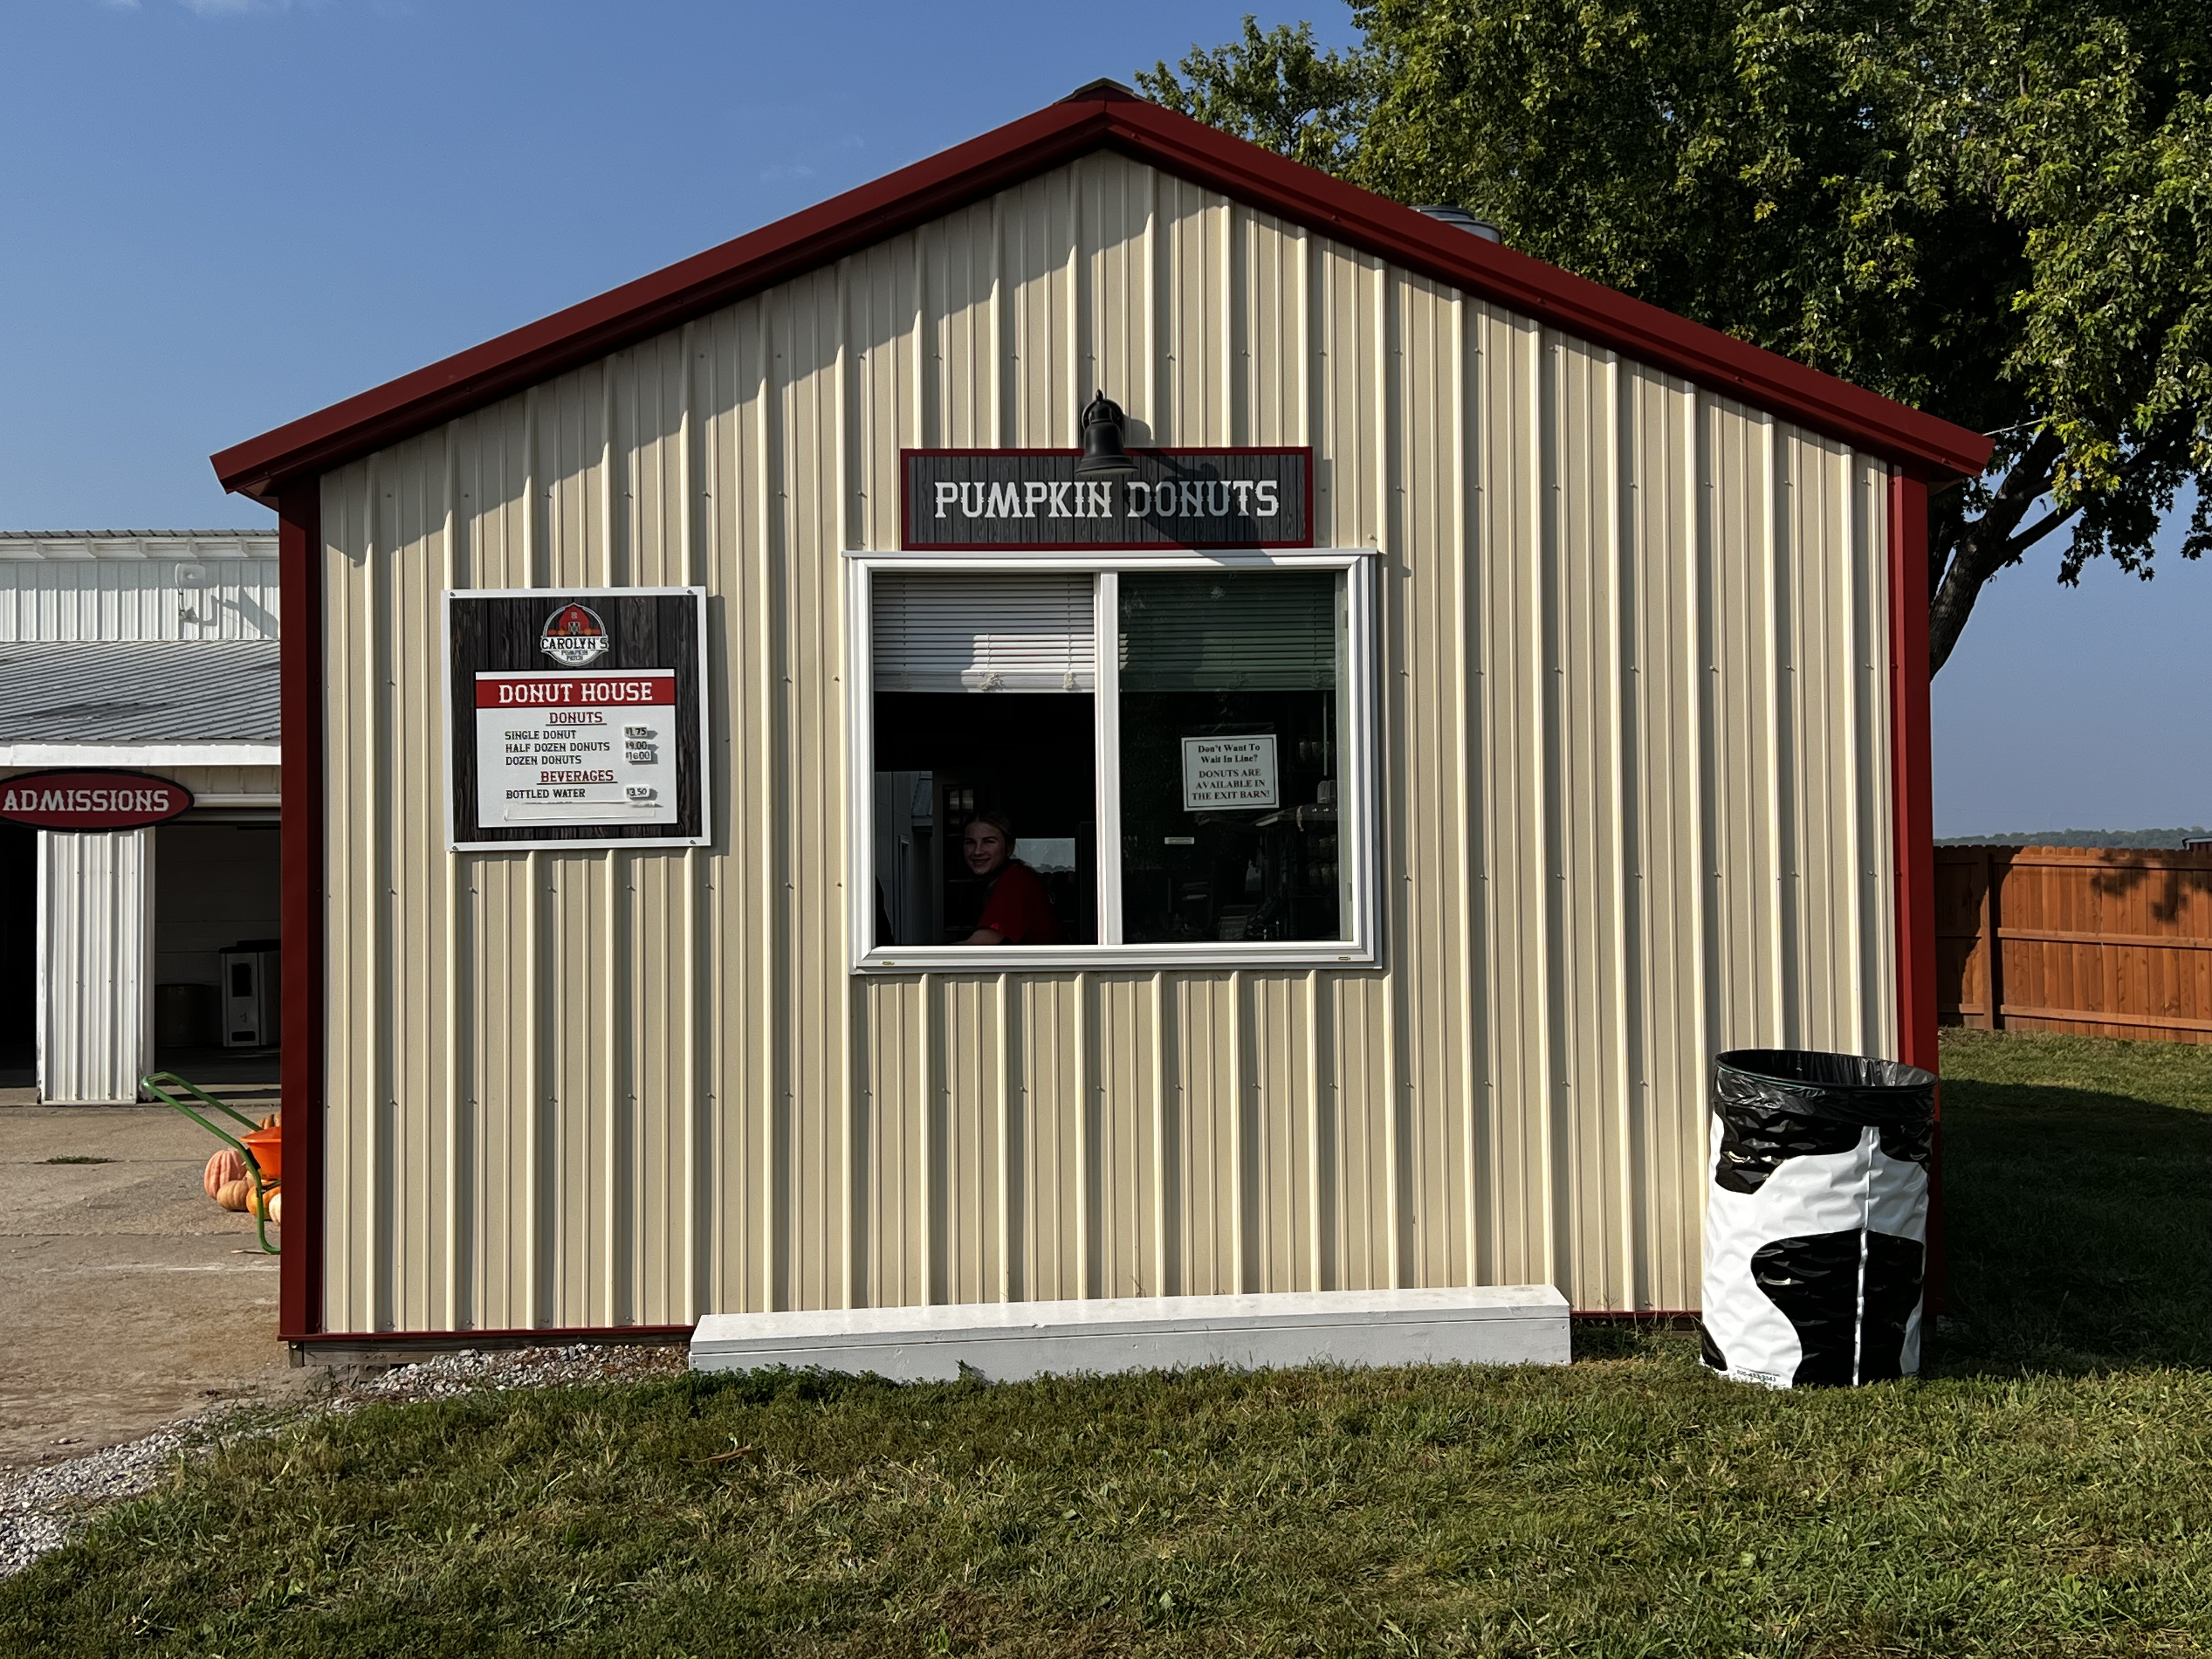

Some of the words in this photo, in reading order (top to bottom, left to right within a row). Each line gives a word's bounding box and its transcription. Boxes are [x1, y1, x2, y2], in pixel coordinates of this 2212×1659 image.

[934, 481, 1113, 518] PUMPKIN
[1127, 480, 1279, 517] DONUTS
[541, 637, 607, 650] CAROLYN'S
[499, 683, 573, 703] DONUT
[580, 682, 653, 702] HOUSE
[549, 711, 603, 724] DONUTS
[505, 730, 540, 740] SINGLE
[543, 730, 577, 739] DONUT
[505, 743, 531, 753] HALF
[534, 743, 566, 752] DOZEN
[569, 742, 610, 752] DONUTS
[1198, 744, 1221, 753] Don't
[1223, 744, 1246, 752] Want
[505, 756, 538, 765] DOZEN
[541, 755, 582, 765] DONUTS
[1200, 755, 1221, 764] Wait
[1234, 754, 1258, 763] Line?
[540, 770, 614, 782] BEVERAGES
[1199, 769, 1239, 778] DONUTS
[1241, 769, 1262, 777] ARE
[1195, 780, 1252, 789] AVAILABLE
[1255, 779, 1265, 787] IN
[506, 789, 549, 799] BOTTLED
[552, 788, 585, 798] WATER
[1192, 792, 1212, 801] THE
[1214, 791, 1238, 800] EXIT
[1240, 790, 1270, 799] BARN!
[2, 789, 169, 812] ADMISSIONS
